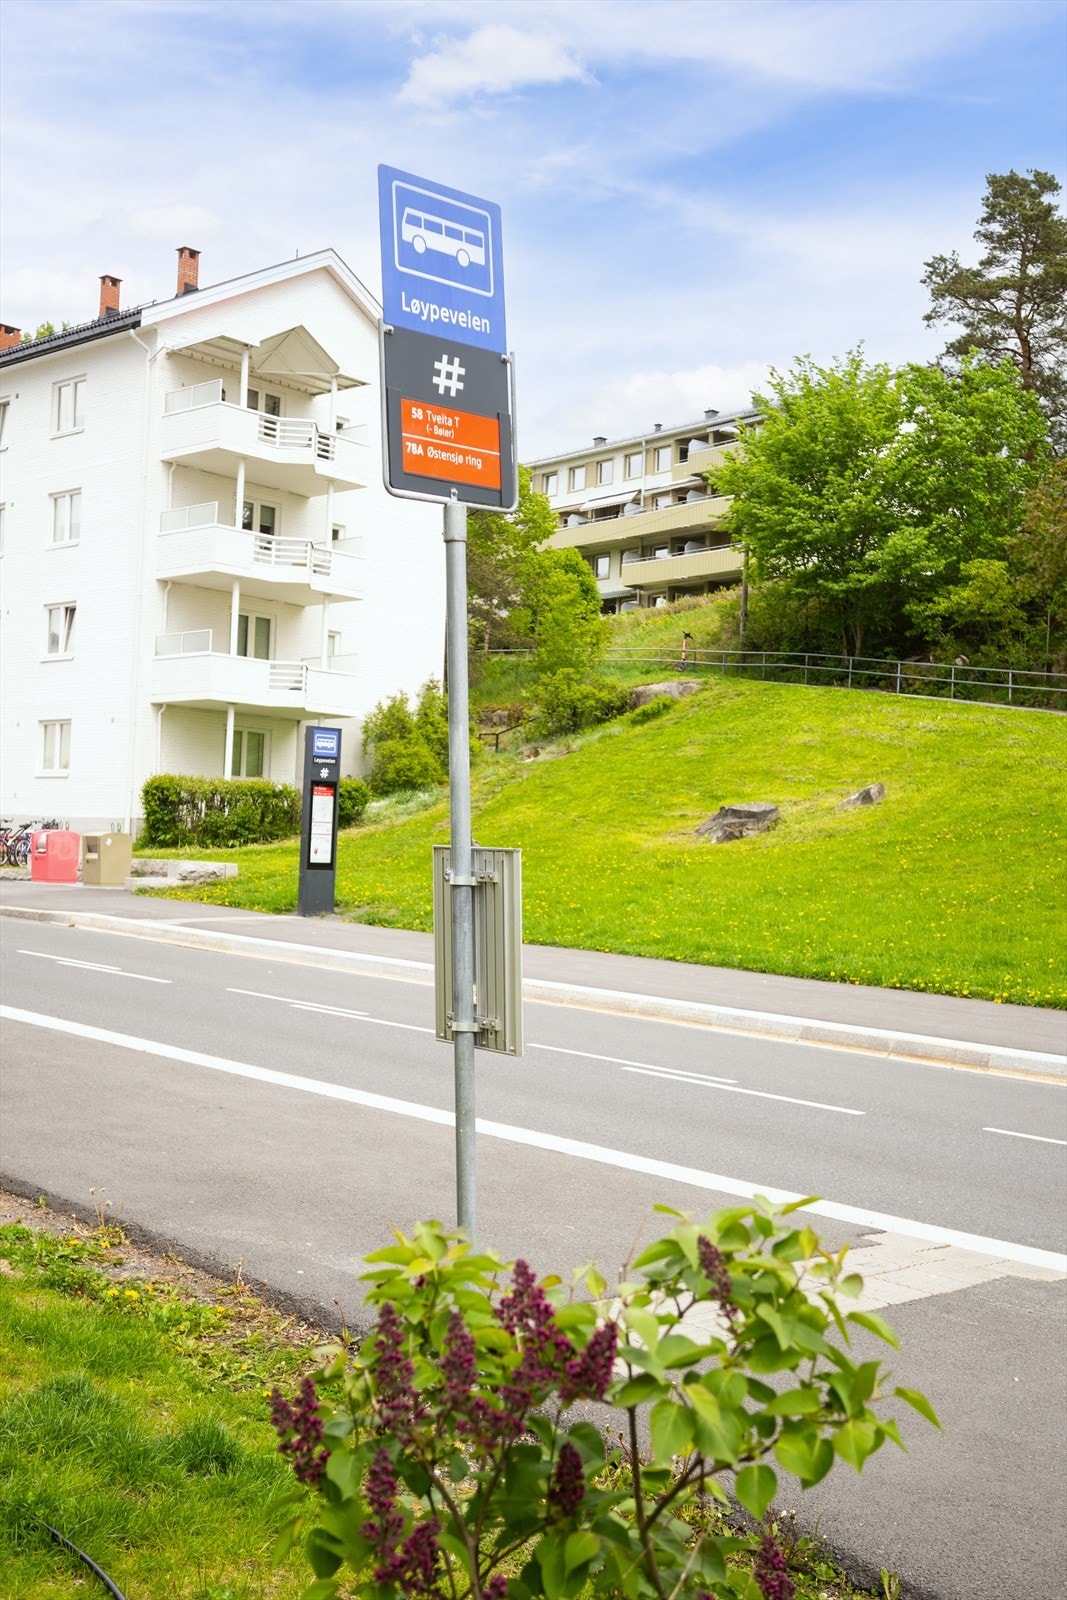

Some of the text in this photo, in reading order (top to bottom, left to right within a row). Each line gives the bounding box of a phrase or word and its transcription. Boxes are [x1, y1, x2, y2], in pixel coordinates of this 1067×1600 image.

[401, 291, 490, 334] Løypeveien
[411, 407, 460, 428] 58 Tveita T
[405, 441, 482, 470] 78A Østensjø ring
